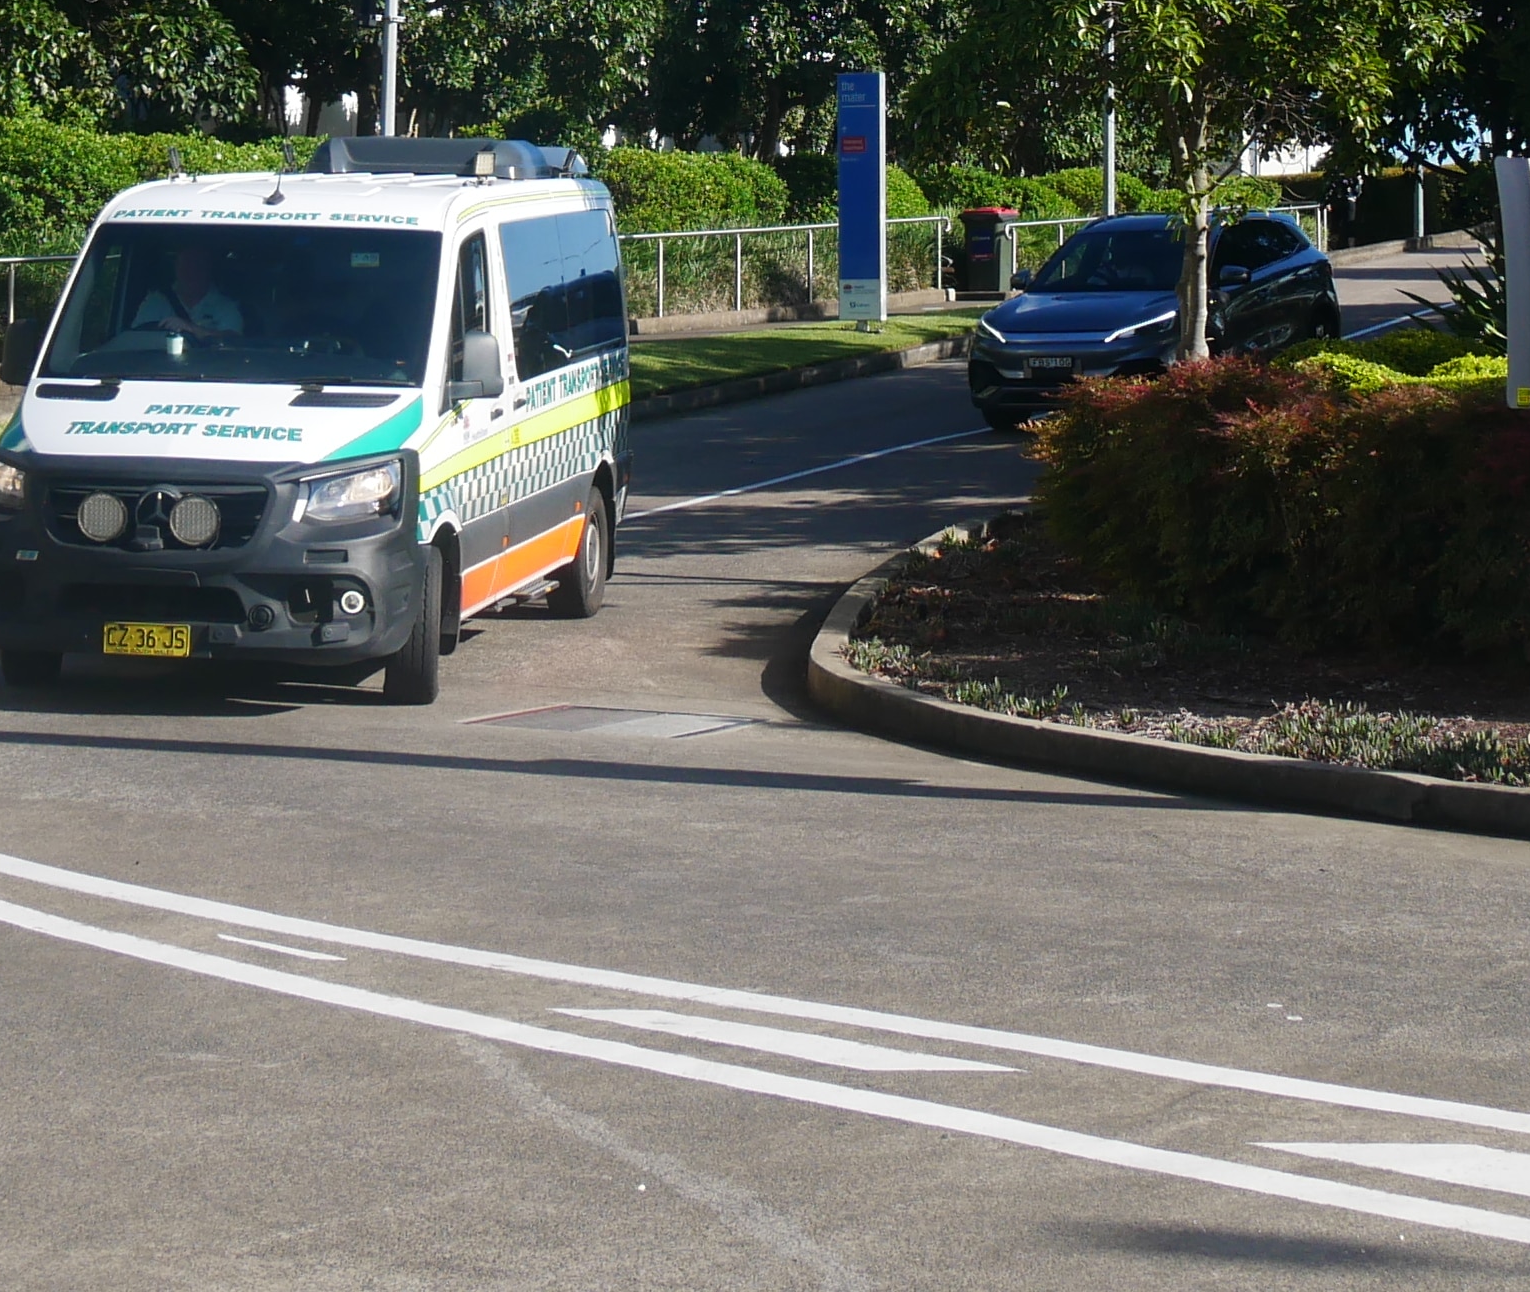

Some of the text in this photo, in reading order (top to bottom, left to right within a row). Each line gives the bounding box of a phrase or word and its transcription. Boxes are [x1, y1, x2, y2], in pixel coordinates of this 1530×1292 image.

[113, 209, 419, 225] PATIENT TRANSPORT SERVICE
[525, 376, 556, 413] PATIENT
[143, 404, 241, 417] PATIENT
[64, 421, 303, 442] TRANSPORT SERVICE
